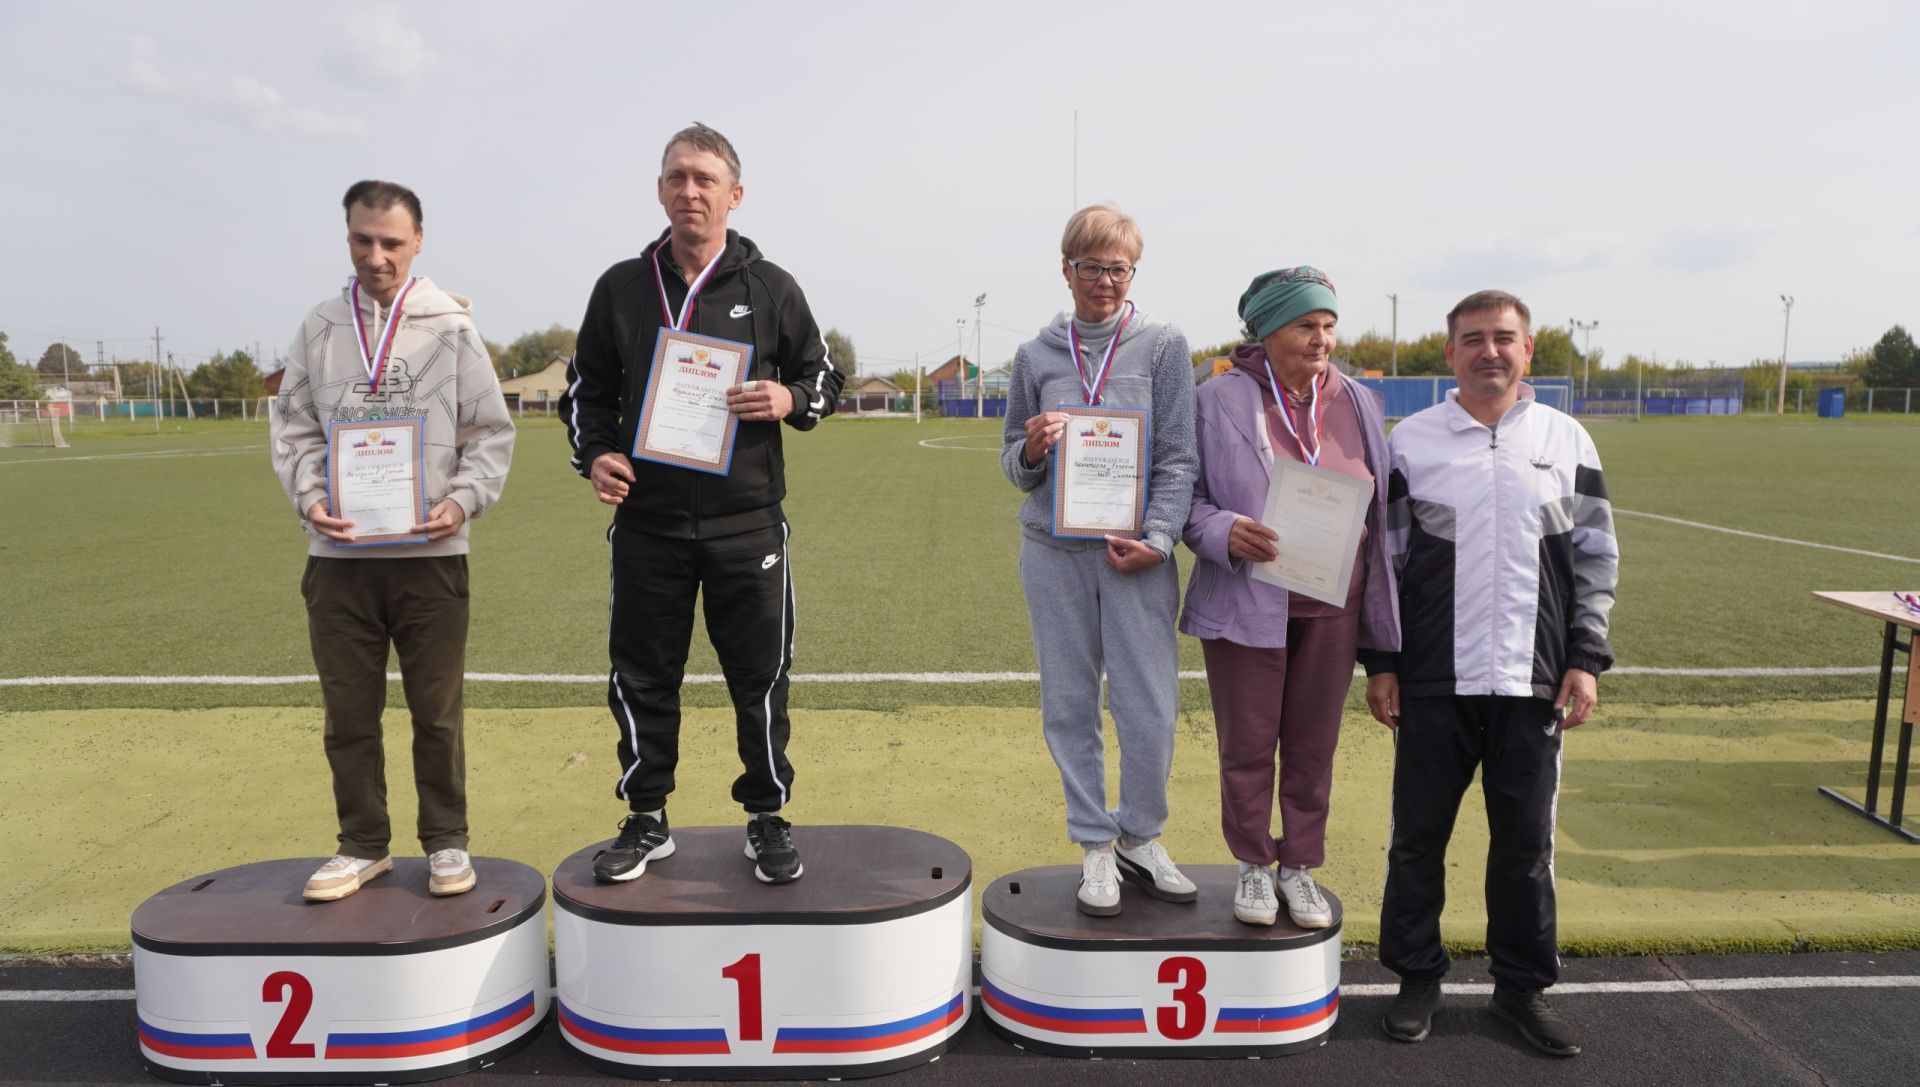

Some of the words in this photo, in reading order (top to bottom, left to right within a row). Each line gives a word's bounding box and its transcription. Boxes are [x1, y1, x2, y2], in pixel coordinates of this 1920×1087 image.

[678, 366, 717, 380] ДИПЛОМ
[329, 406, 430, 422] ABIOENESIS
[1082, 440, 1120, 448] ДИПЛОМ
[355, 448, 394, 457] ДИПЛОМ
[722, 954, 762, 1040] 1
[1157, 956, 1207, 1040] 3
[262, 971, 315, 1058] 2
